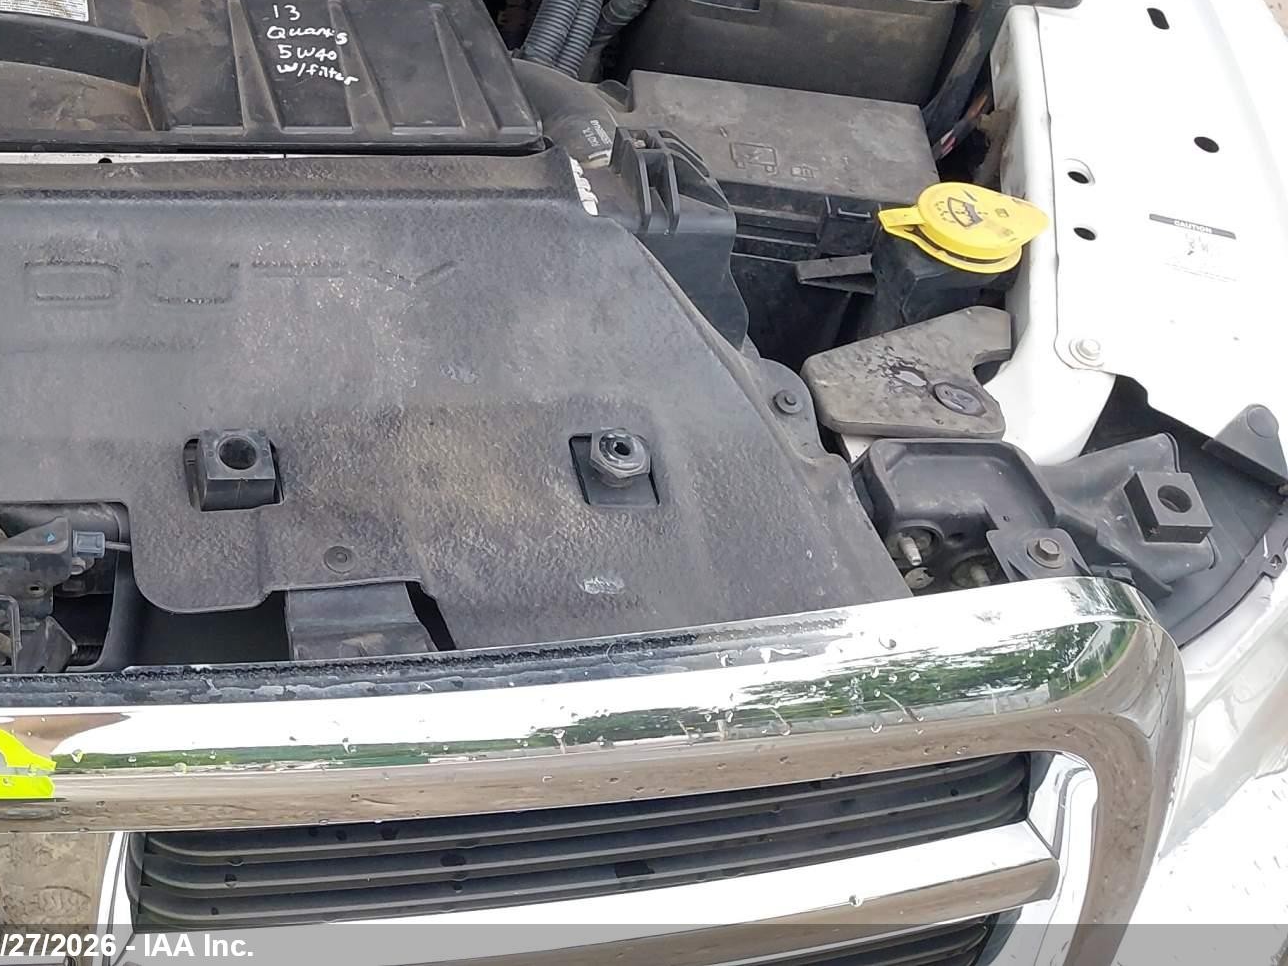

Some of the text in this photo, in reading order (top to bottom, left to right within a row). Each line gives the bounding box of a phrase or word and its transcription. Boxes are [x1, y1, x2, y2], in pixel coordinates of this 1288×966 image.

[272, 4, 301, 21] 13
[1174, 220, 1213, 234] CAUTION
[23, 259, 458, 313] DUTY
